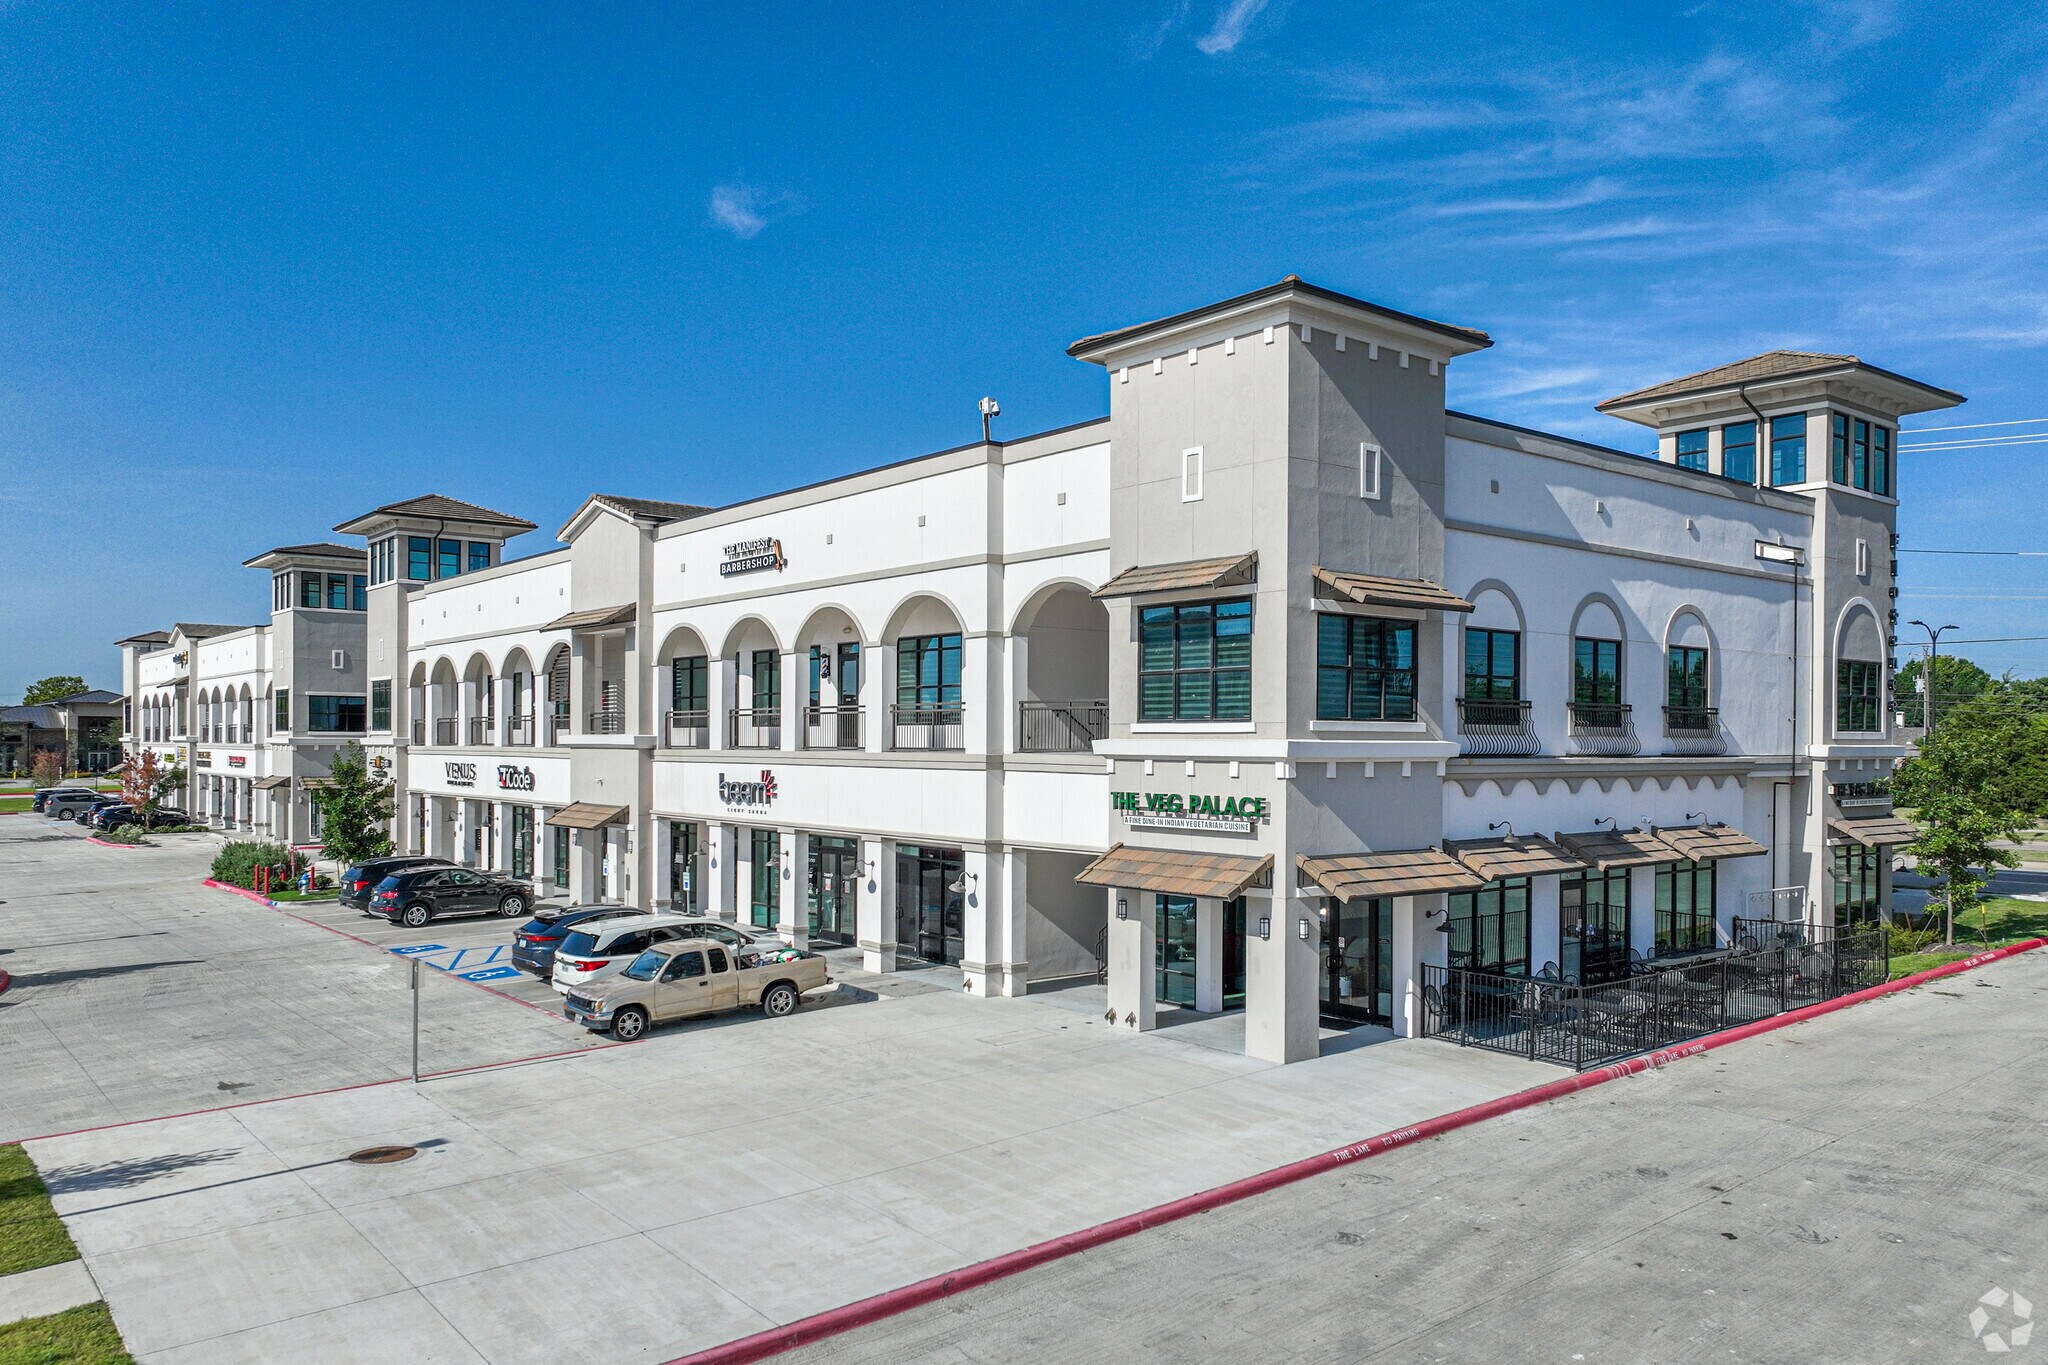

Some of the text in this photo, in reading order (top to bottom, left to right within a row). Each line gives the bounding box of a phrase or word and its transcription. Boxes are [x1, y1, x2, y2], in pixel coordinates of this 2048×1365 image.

[721, 556, 774, 574] BARBERSHOP
[445, 762, 477, 781] VENUS
[719, 773, 769, 806] beem
[1110, 791, 1266, 817] THE VEG PALACE
[1142, 818, 1164, 826] DINE-IN
[1164, 819, 1185, 827] INDIAN
[1185, 820, 1224, 830] VEGETARIAN
[1224, 821, 1249, 831] CUISINE
[1333, 1127, 1420, 1161] FIRE LANE NO PARKING
